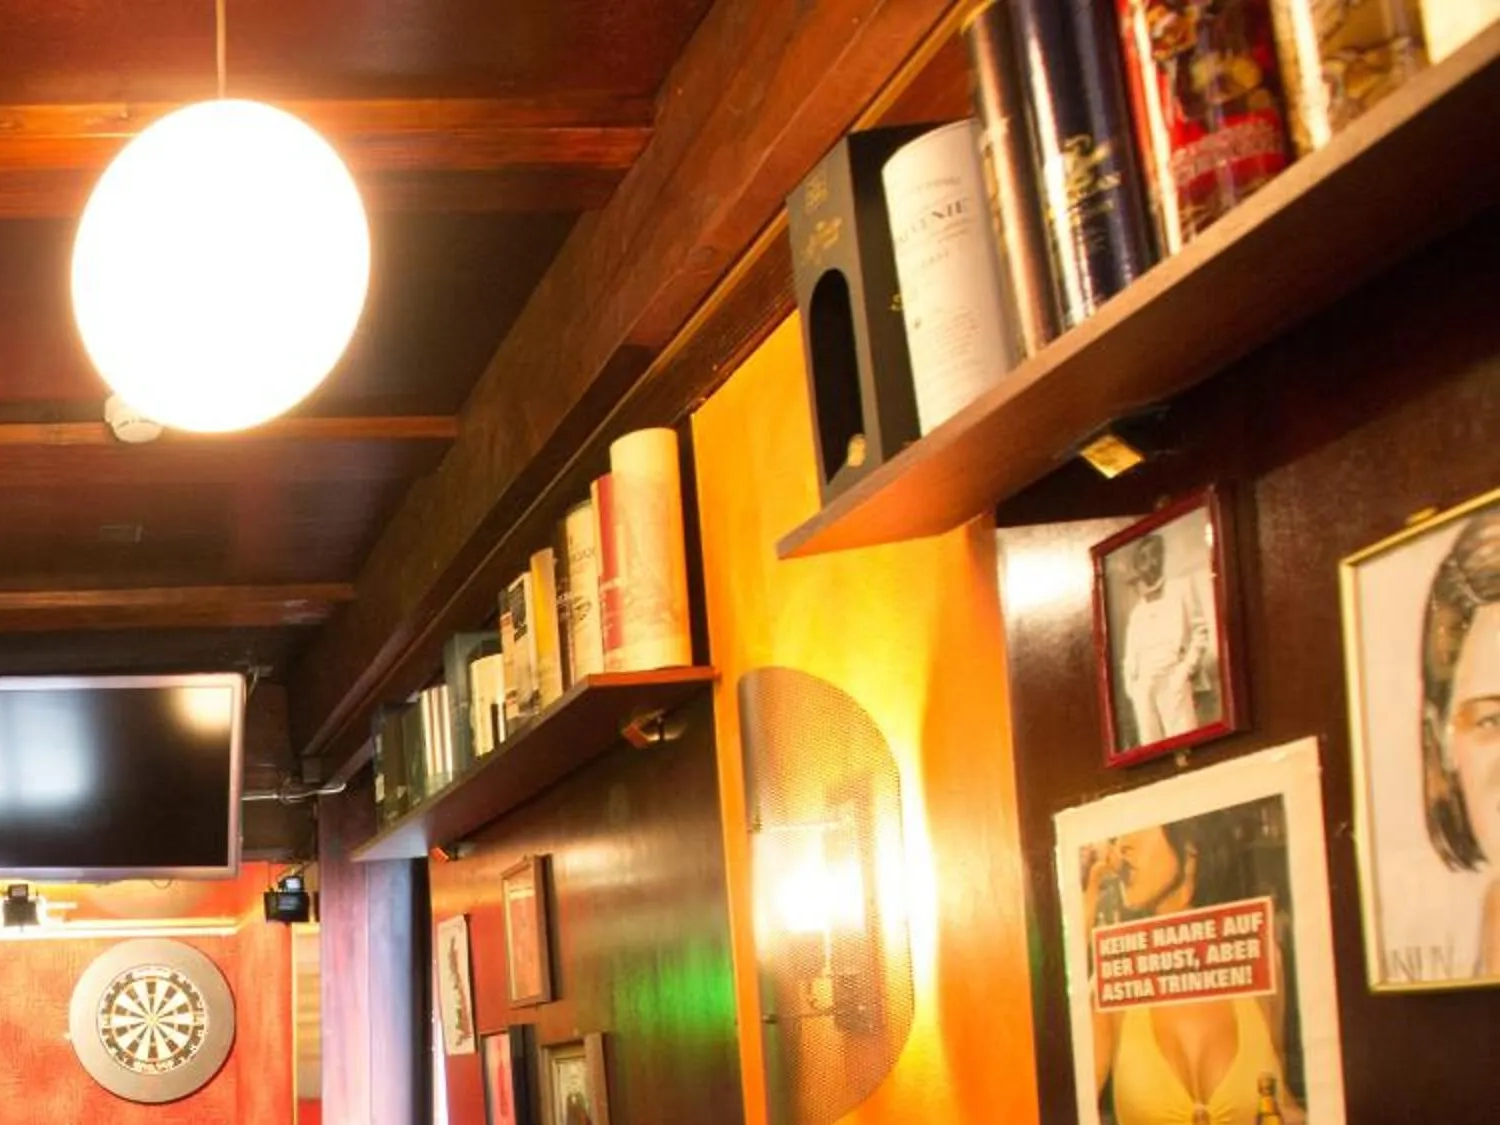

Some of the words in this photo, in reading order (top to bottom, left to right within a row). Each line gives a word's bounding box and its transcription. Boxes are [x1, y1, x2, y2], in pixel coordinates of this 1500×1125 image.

[1100, 931, 1148, 957] KEINE
[1152, 919, 1216, 947] HAARE
[1223, 911, 1264, 937] AUF
[1100, 957, 1134, 980] DER
[1136, 947, 1201, 975] BRUST,
[1205, 938, 1261, 965] ABER
[1102, 979, 1155, 1002] ASTRA
[1157, 965, 1253, 995] TRINKEN!
